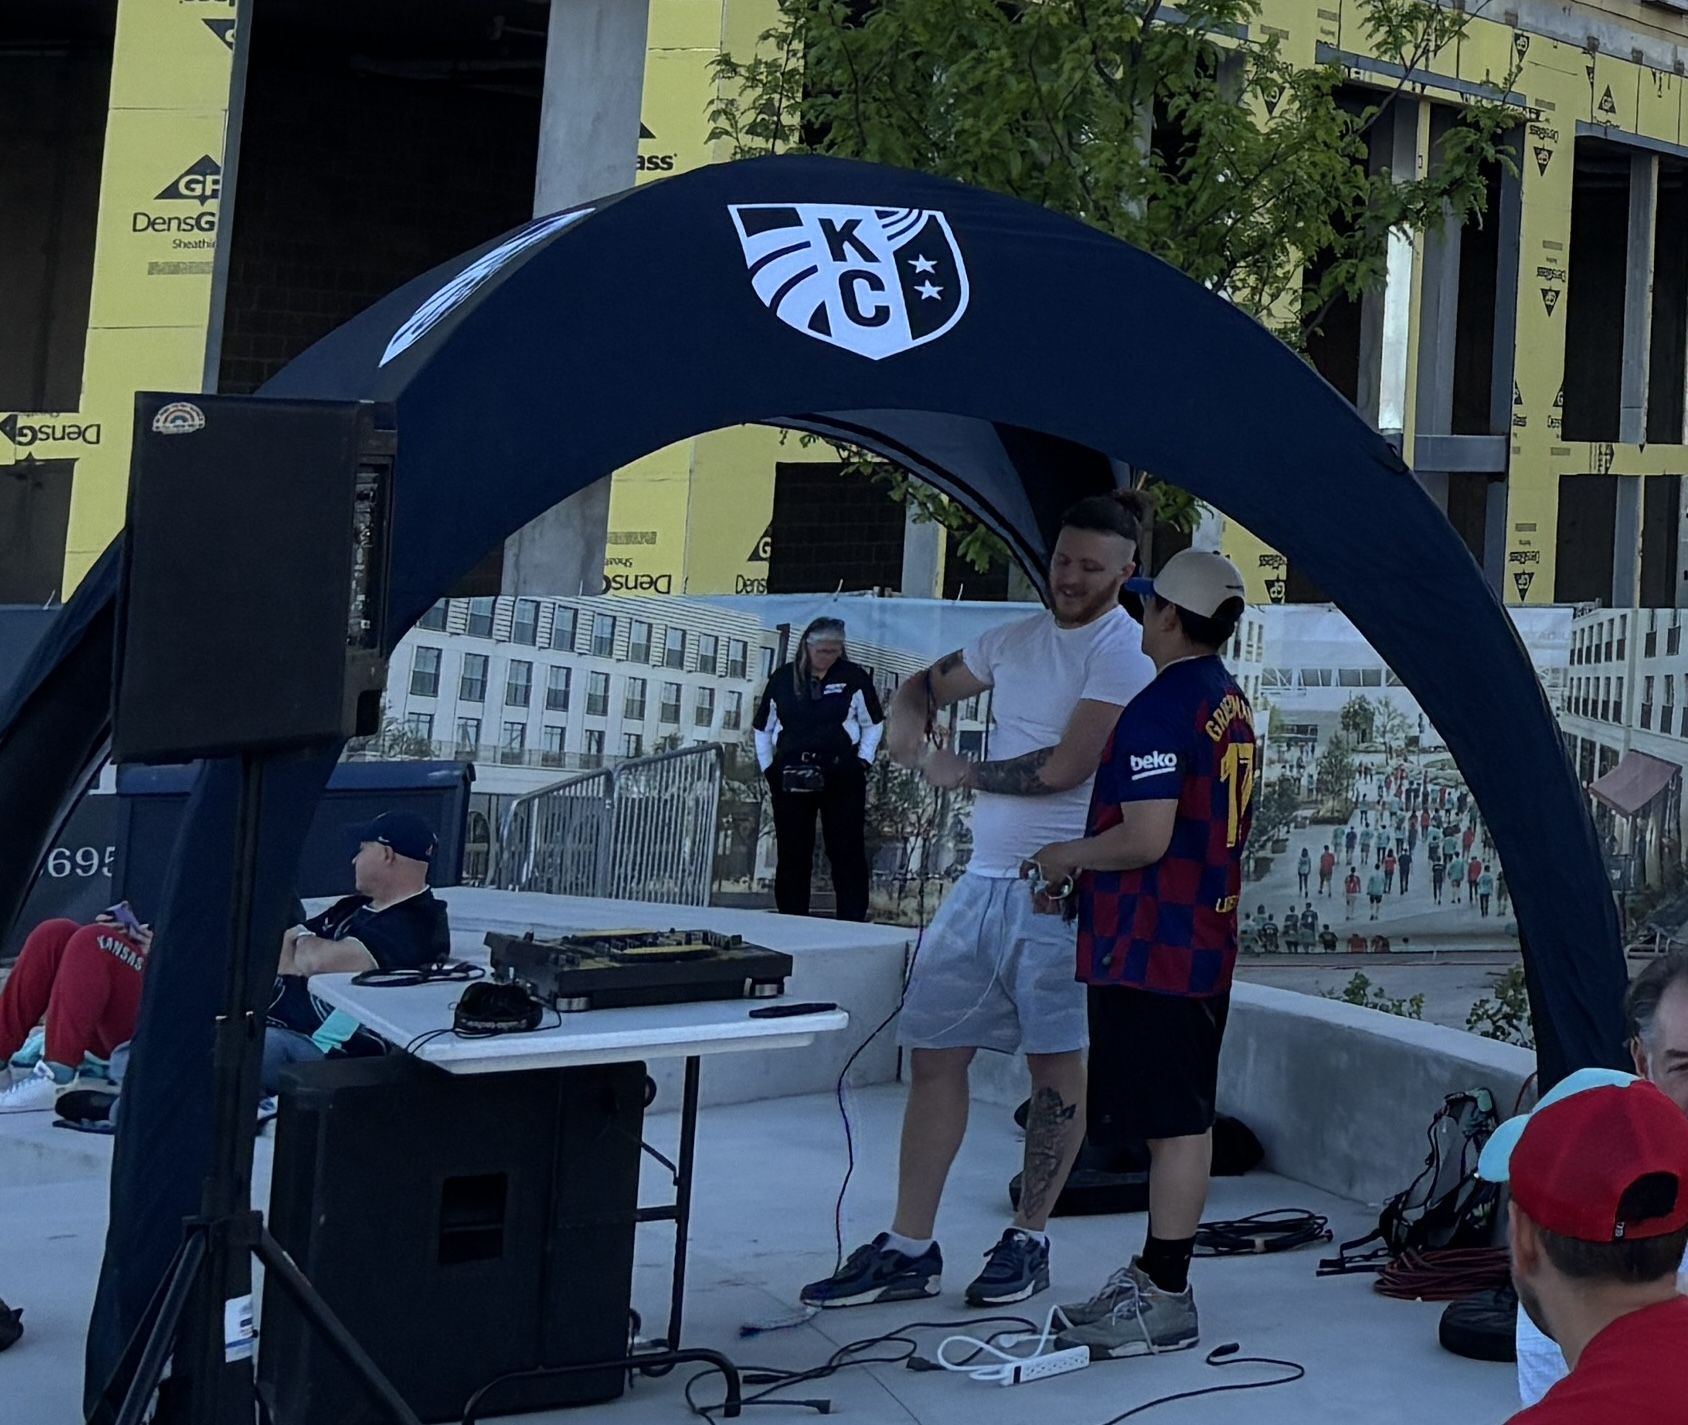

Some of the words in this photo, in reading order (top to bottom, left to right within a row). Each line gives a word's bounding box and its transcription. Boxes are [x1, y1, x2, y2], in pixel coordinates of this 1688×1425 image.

[1130, 750, 1178, 772] beko
[1220, 742, 1255, 848] 17
[96, 934, 146, 971] KANSAS
